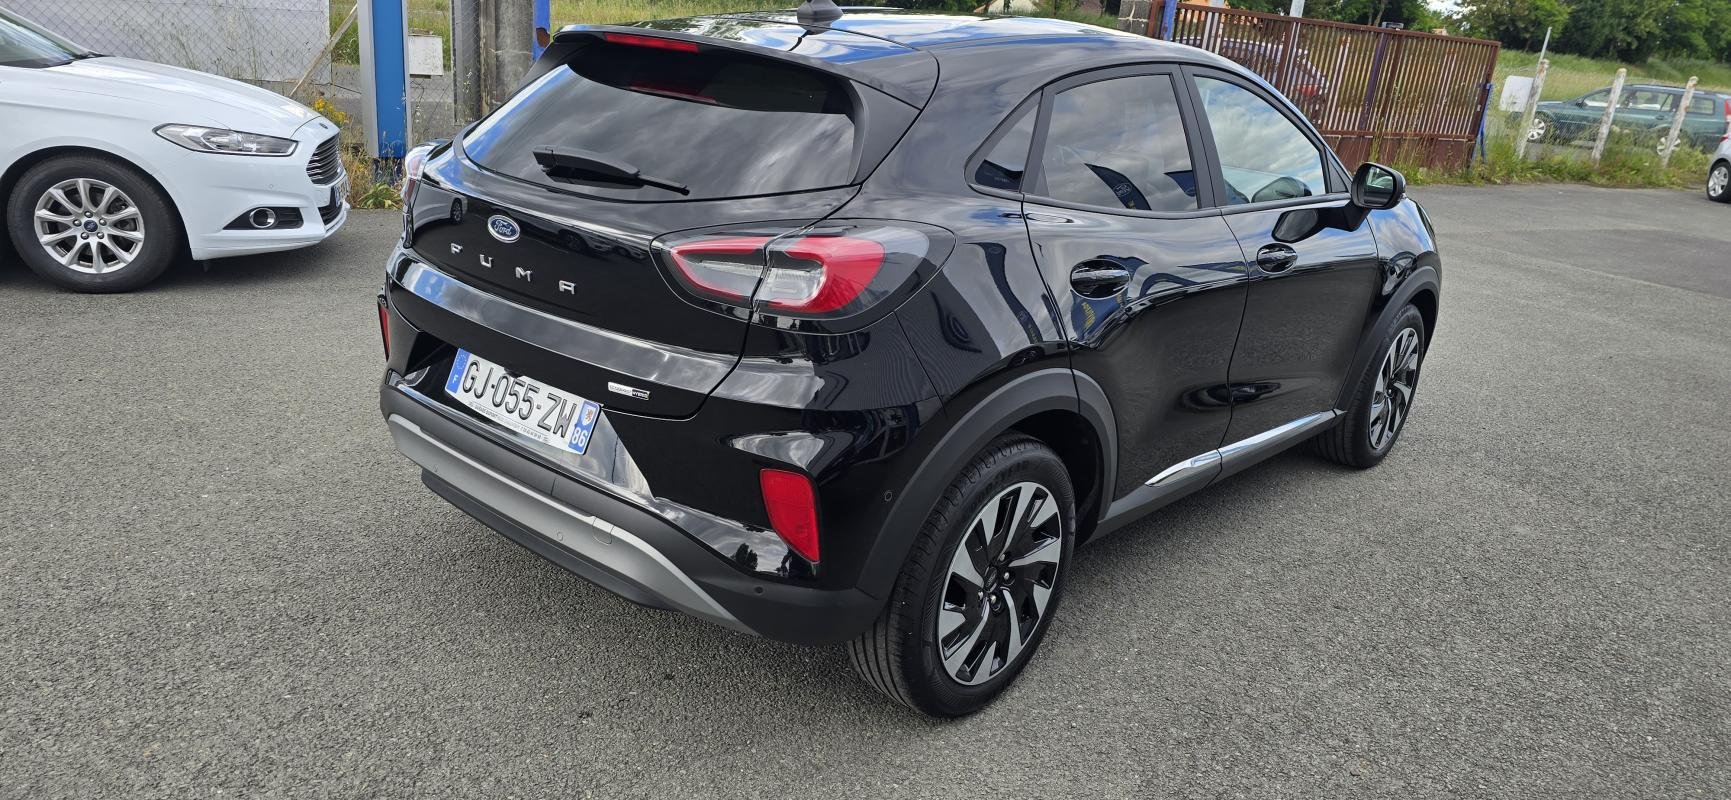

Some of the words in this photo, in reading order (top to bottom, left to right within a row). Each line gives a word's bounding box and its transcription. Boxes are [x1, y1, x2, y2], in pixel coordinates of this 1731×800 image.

[493, 219, 512, 236] Ford
[450, 242, 577, 295] PUMA
[452, 374, 459, 384] F
[462, 359, 578, 439] GJ-055-ZW
[571, 426, 588, 448] 86
